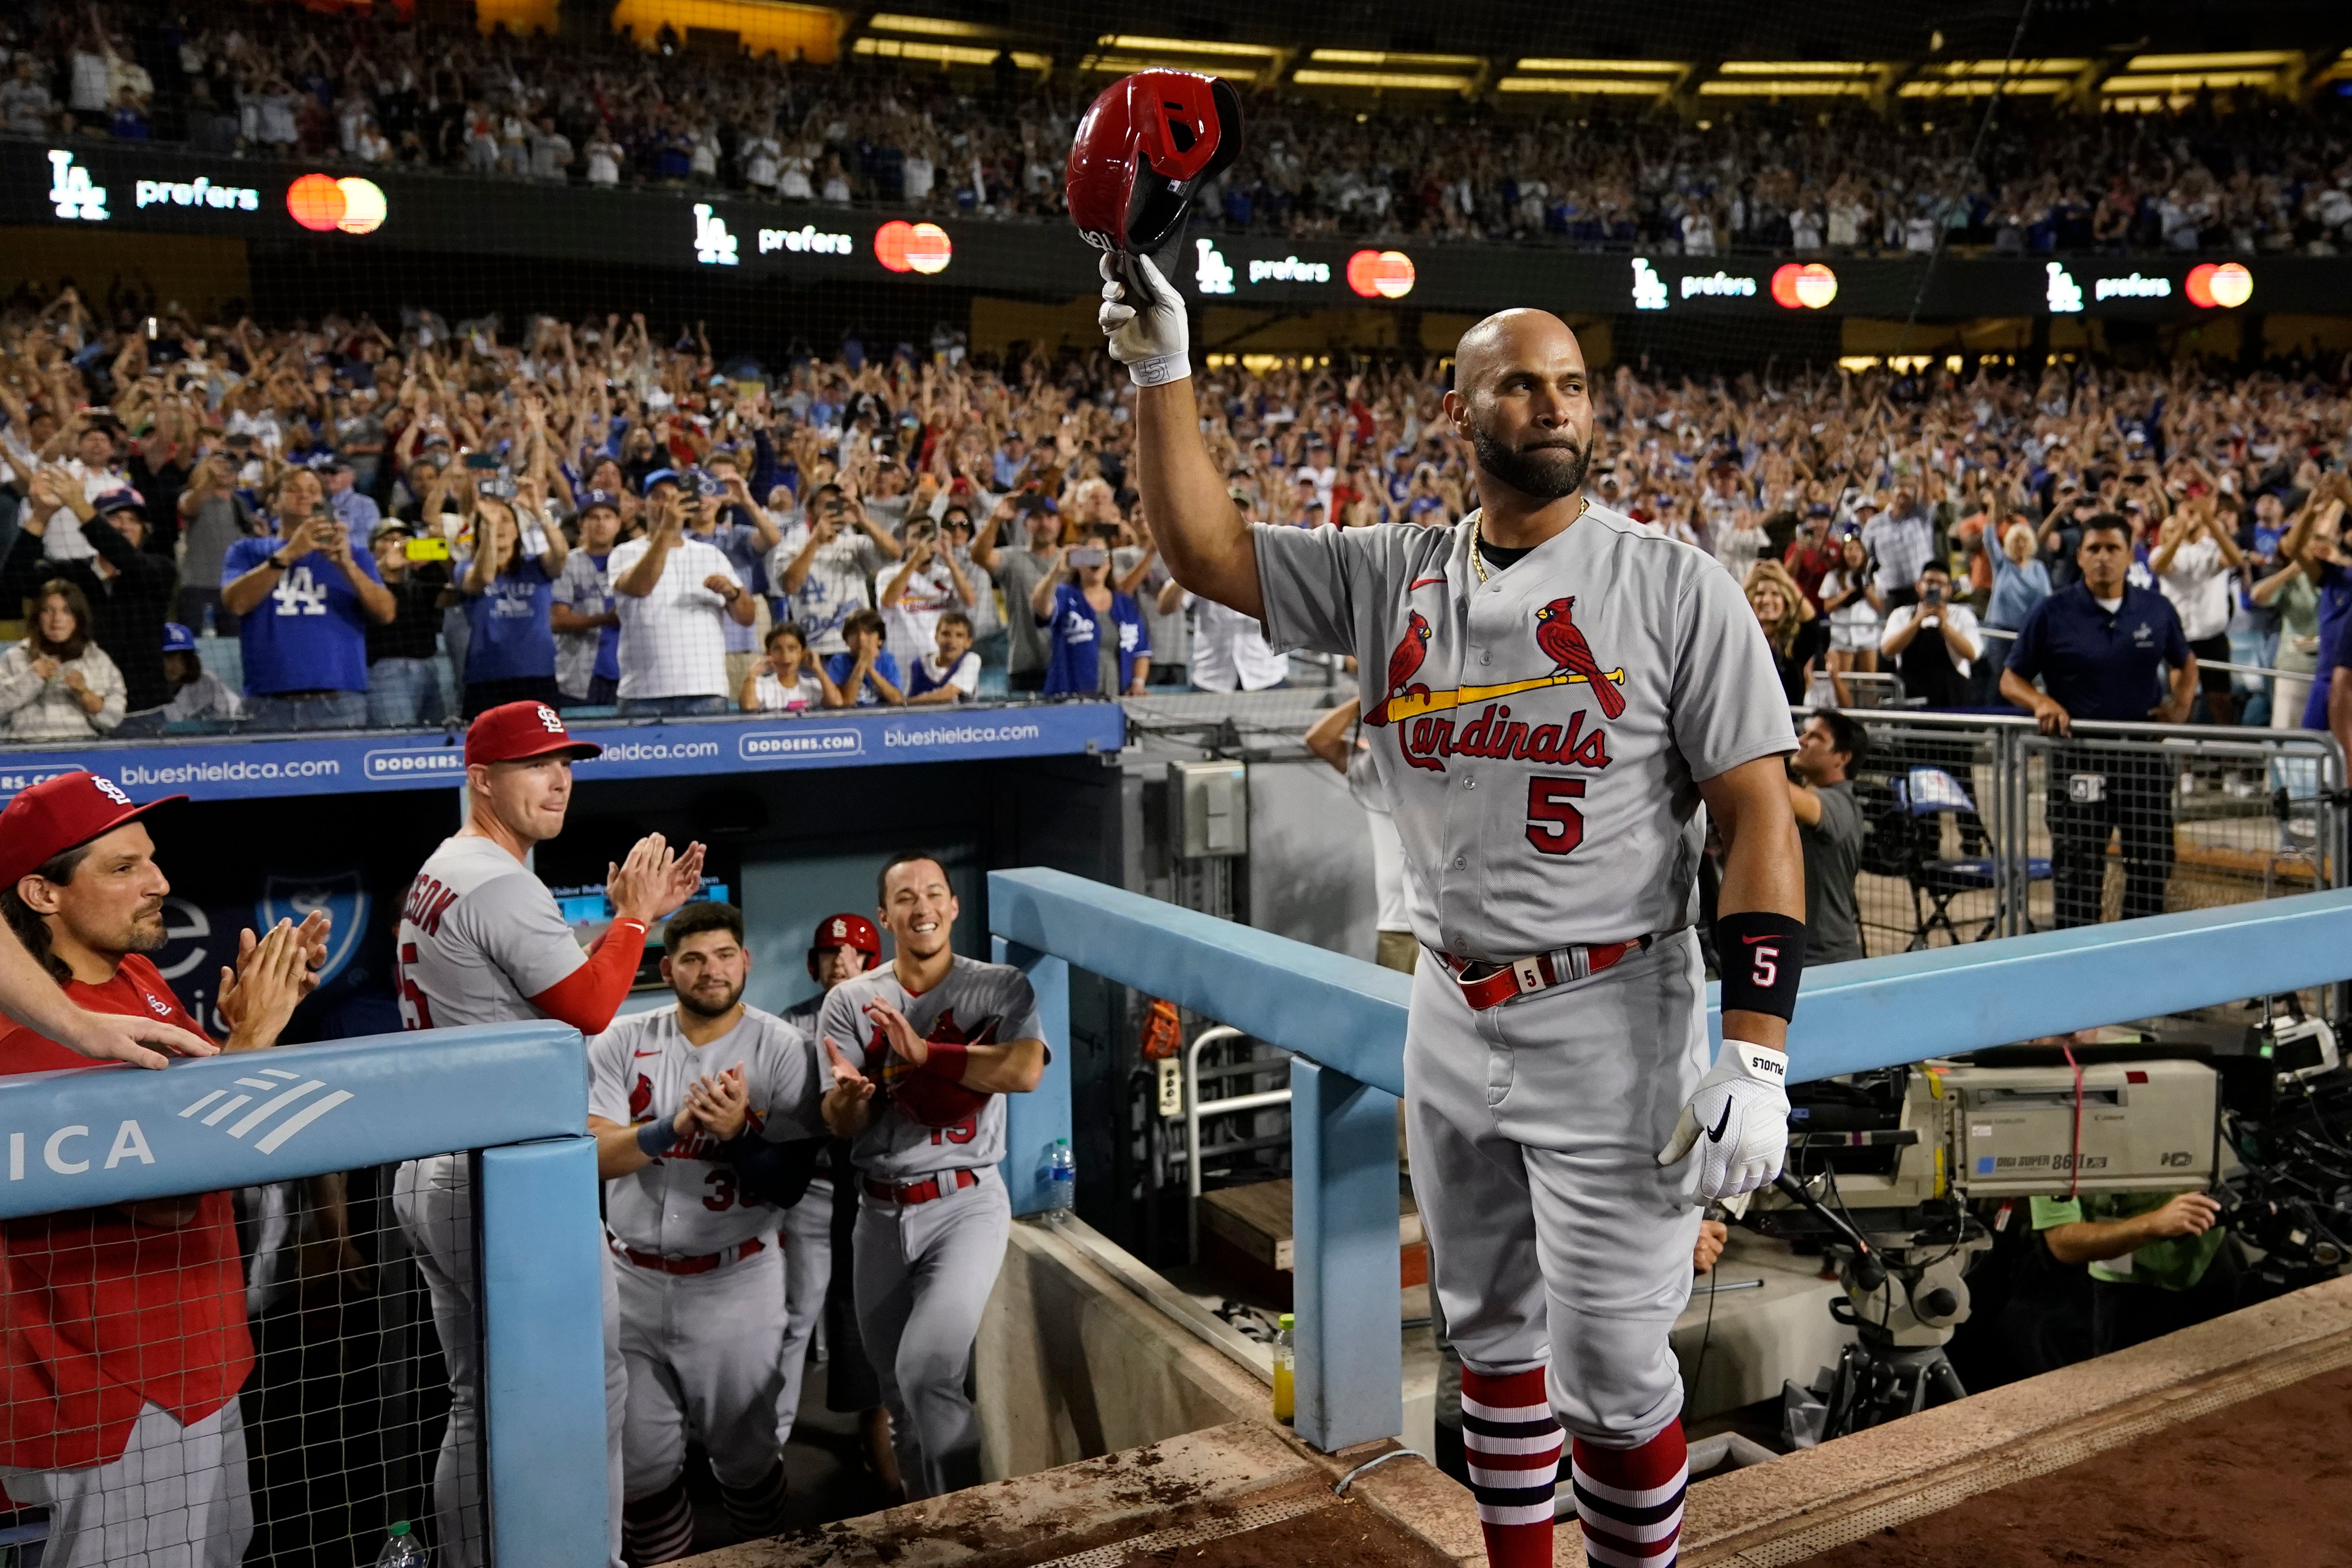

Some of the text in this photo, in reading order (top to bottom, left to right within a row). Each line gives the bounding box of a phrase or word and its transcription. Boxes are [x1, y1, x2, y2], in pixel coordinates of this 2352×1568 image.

[136, 176, 259, 211] prefers
[759, 225, 852, 255] prefers
[1249, 256, 1330, 284] prefers
[1681, 271, 1757, 299] prefers
[2095, 273, 2171, 301] prefers
[884, 725, 1039, 748] blueshieldca.com
[1399, 683, 1613, 772] Cardinals
[748, 736, 854, 752] DODGERS.COM
[121, 759, 340, 786] blueshieldca.com
[1525, 775, 1586, 855] 5
[1524, 970, 1537, 988] 5
[1751, 946, 1779, 988] 5
[1752, 1057, 1784, 1076] PUJOLS
